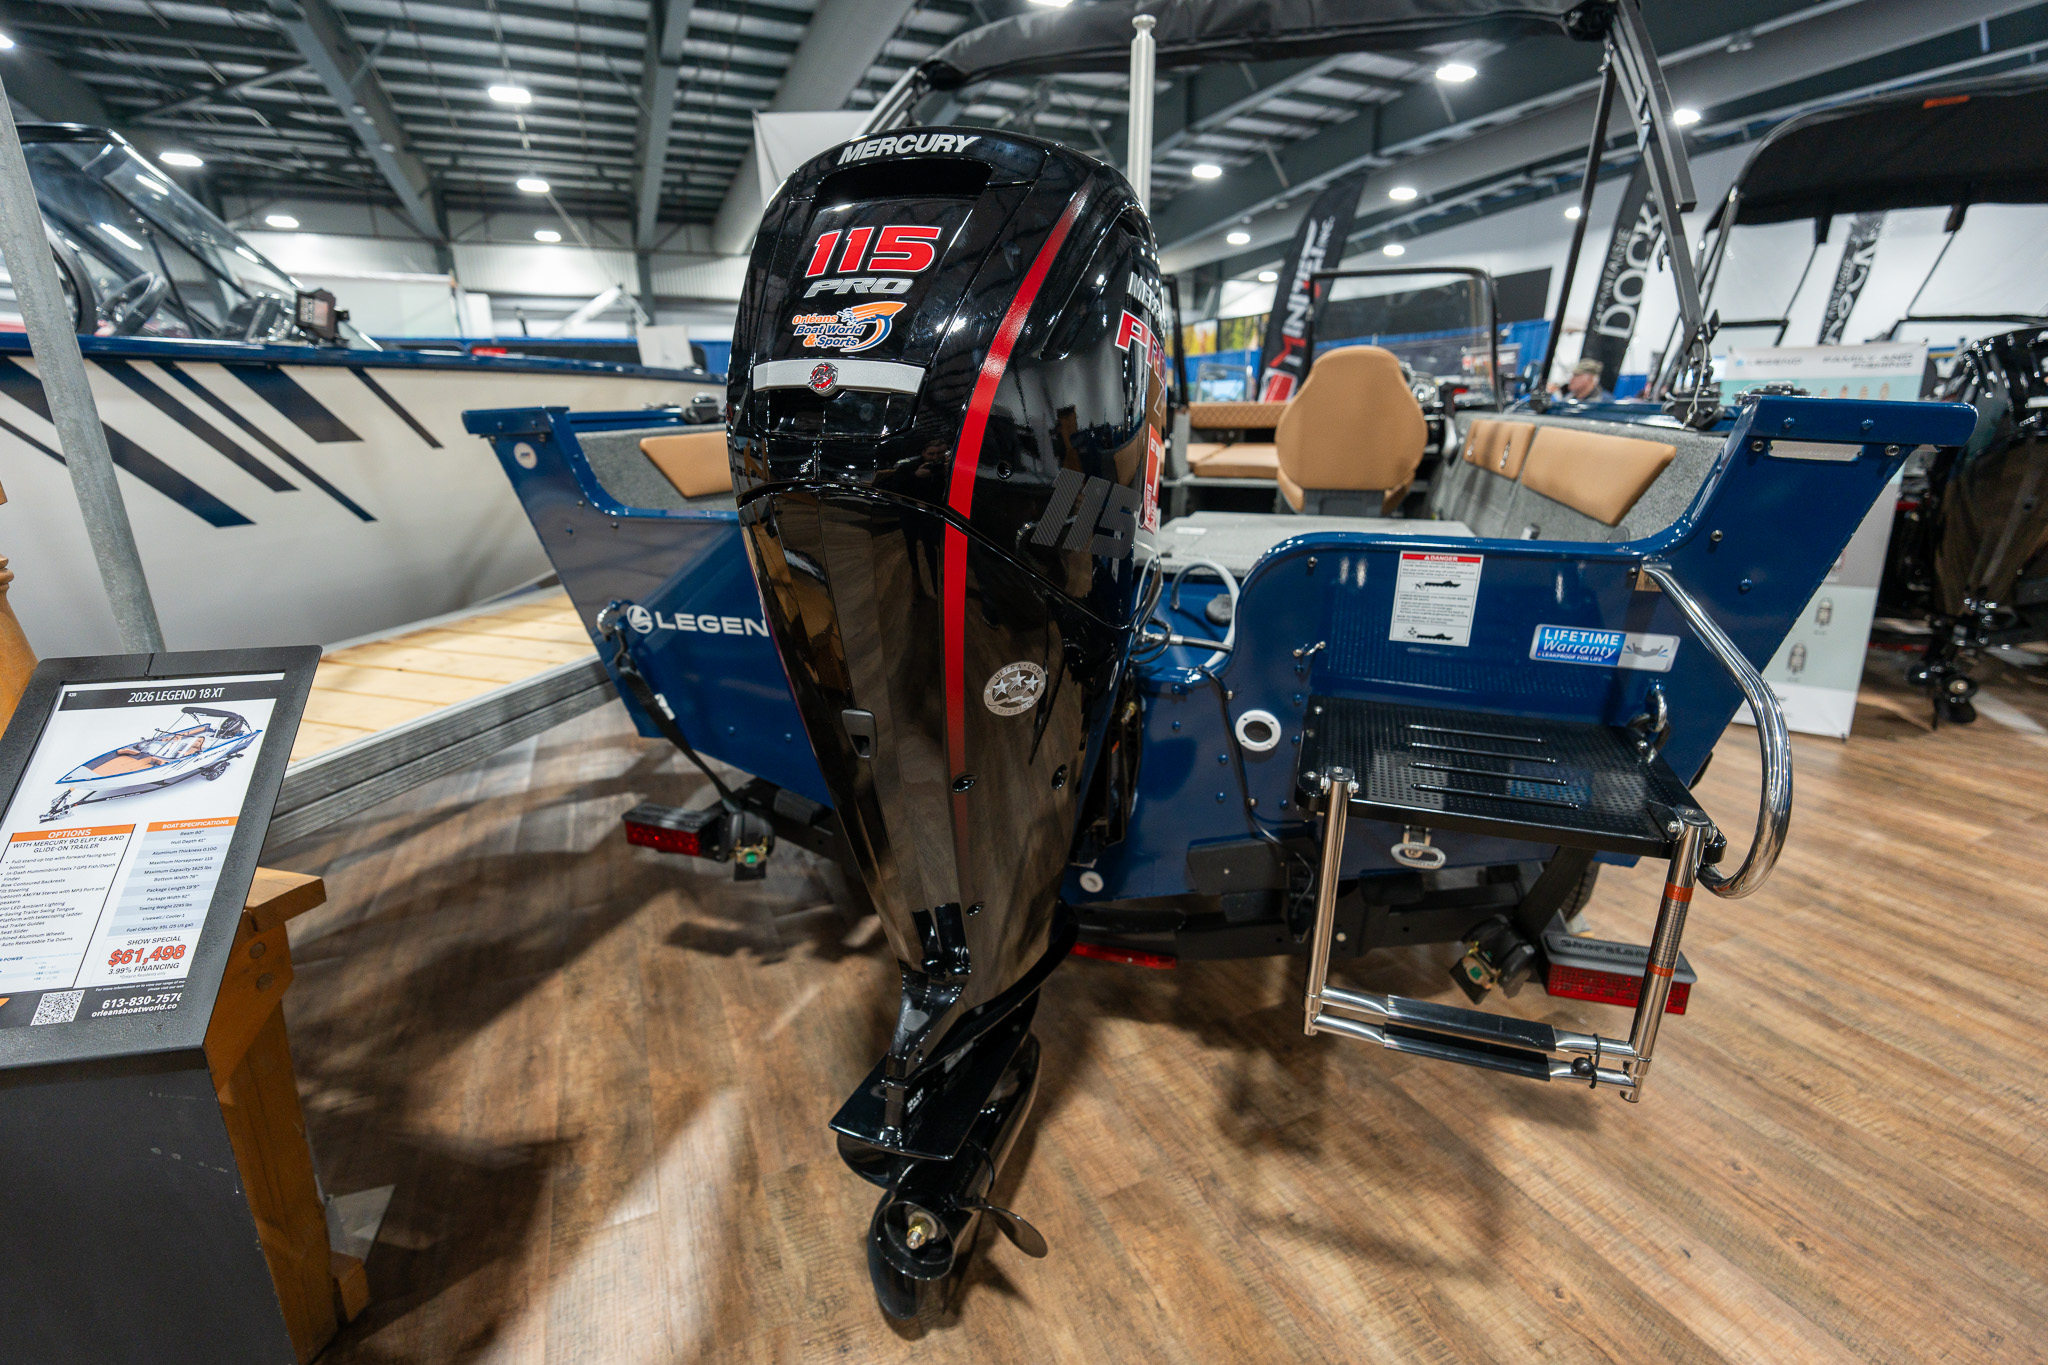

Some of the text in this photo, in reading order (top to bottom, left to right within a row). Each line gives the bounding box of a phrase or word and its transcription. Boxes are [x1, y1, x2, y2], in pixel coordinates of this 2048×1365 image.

[837, 133, 981, 165] MERCURY
[805, 225, 943, 278] 115
[803, 277, 914, 298] PRO
[792, 314, 838, 324] Orléans
[793, 325, 867, 335] Boat World
[803, 334, 859, 348] & Sports
[655, 611, 769, 637] LEGEN
[1544, 629, 1620, 645] LIFETIME
[1541, 652, 1576, 660] LEAKPROOF
[1543, 640, 1616, 659] Warranty
[128, 687, 225, 702] 2026 LEGEND 18 XT
[180, 820, 229, 828] SPECIFICATIONS
[48, 829, 91, 839] OPTIONS
[33, 839, 68, 847] MERCURY
[152, 936, 182, 944] SPECIAL
[108, 944, 186, 967] $61,498
[108, 962, 179, 975] 3.99% FINANCING
